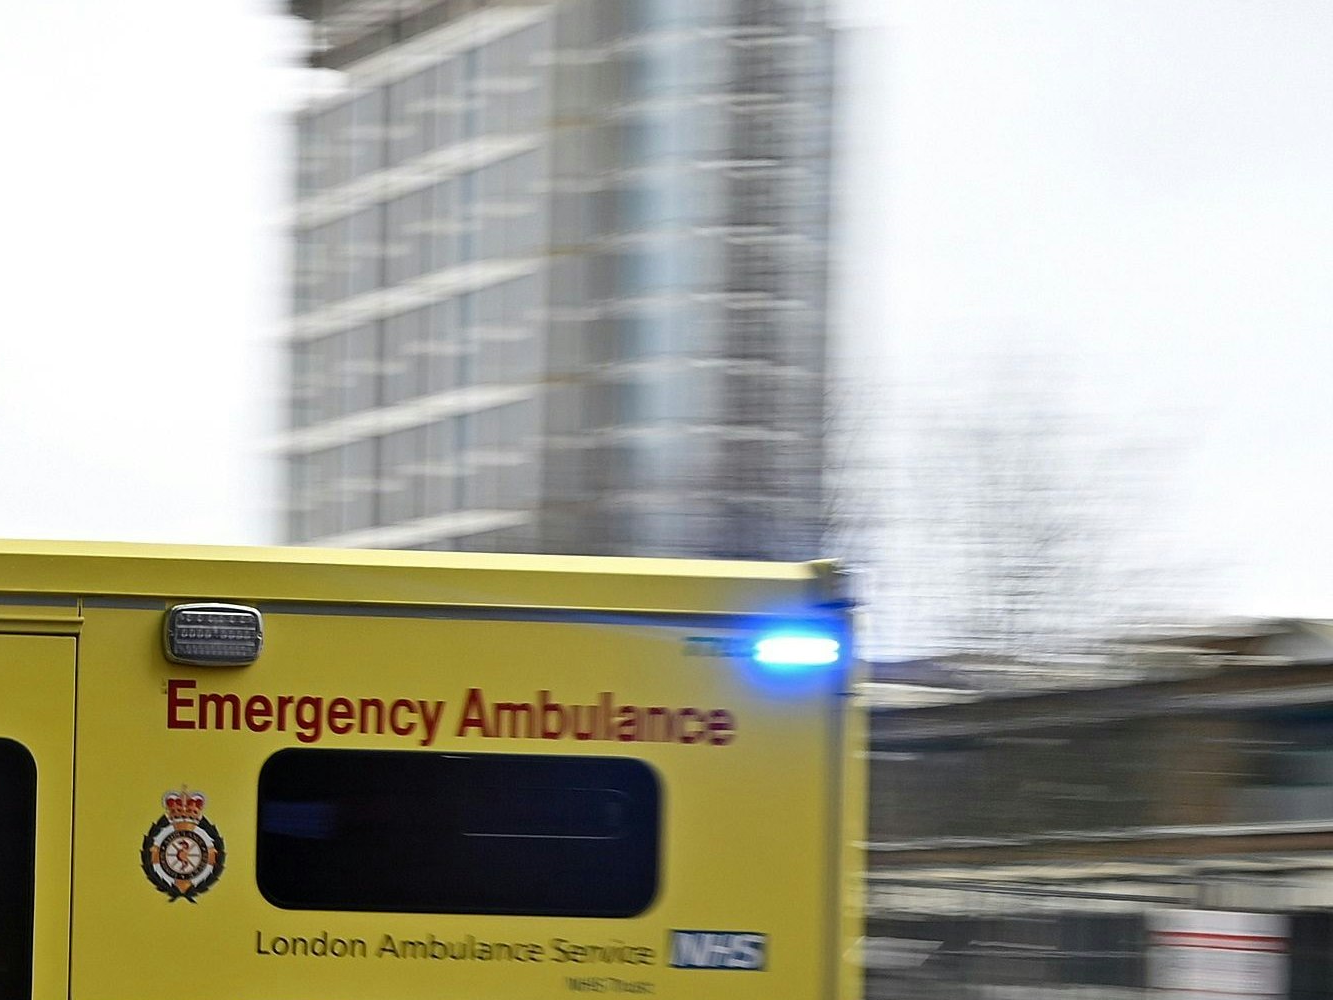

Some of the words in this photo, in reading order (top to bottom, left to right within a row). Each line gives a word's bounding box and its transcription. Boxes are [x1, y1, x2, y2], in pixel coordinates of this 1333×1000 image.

[167, 679, 444, 746] Emergency
[457, 687, 737, 747] Ambulance
[256, 930, 367, 957] London
[376, 933, 544, 964] Ambulance
[551, 937, 655, 966] Service
[670, 931, 766, 969] NHS
